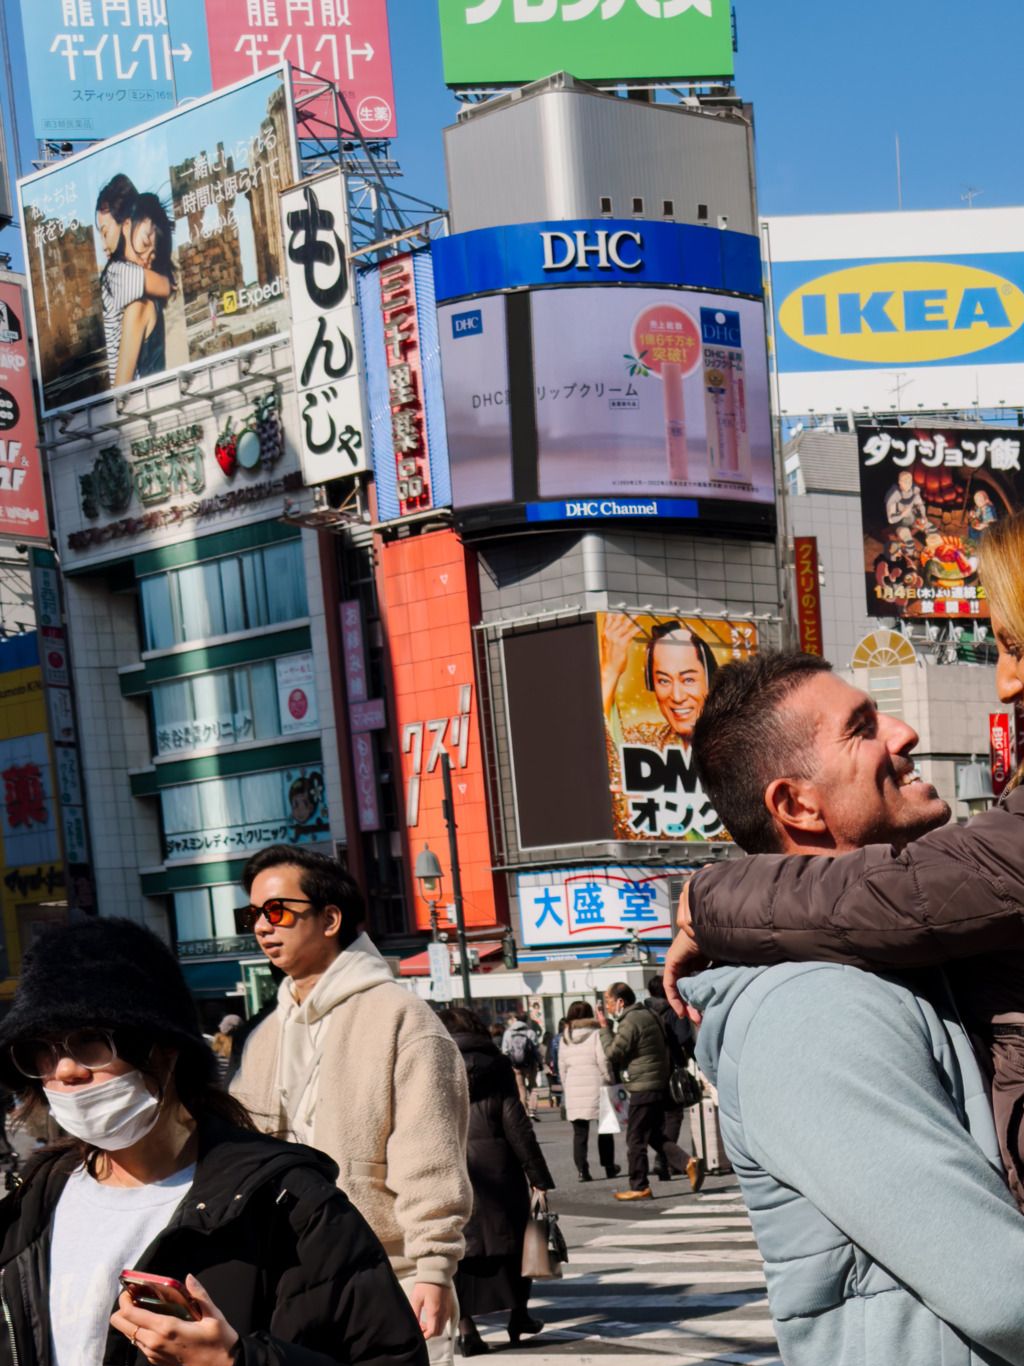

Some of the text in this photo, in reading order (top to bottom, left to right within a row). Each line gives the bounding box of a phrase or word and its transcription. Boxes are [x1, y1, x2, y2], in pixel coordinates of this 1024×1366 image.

[73, 90, 127, 102] スティック
[359, 106, 391, 124] 生薬
[182, 158, 280, 215] 時間は限られて
[540, 230, 643, 271] DHC
[286, 186, 362, 467] もんじゃ
[455, 316, 481, 332] DHC
[801, 287, 1013, 337] IKEA
[703, 324, 740, 343] DHC
[863, 432, 1022, 472] ダンジョン飯
[565, 502, 658, 517] DHC Channel
[533, 882, 659, 929] 大盛堂
